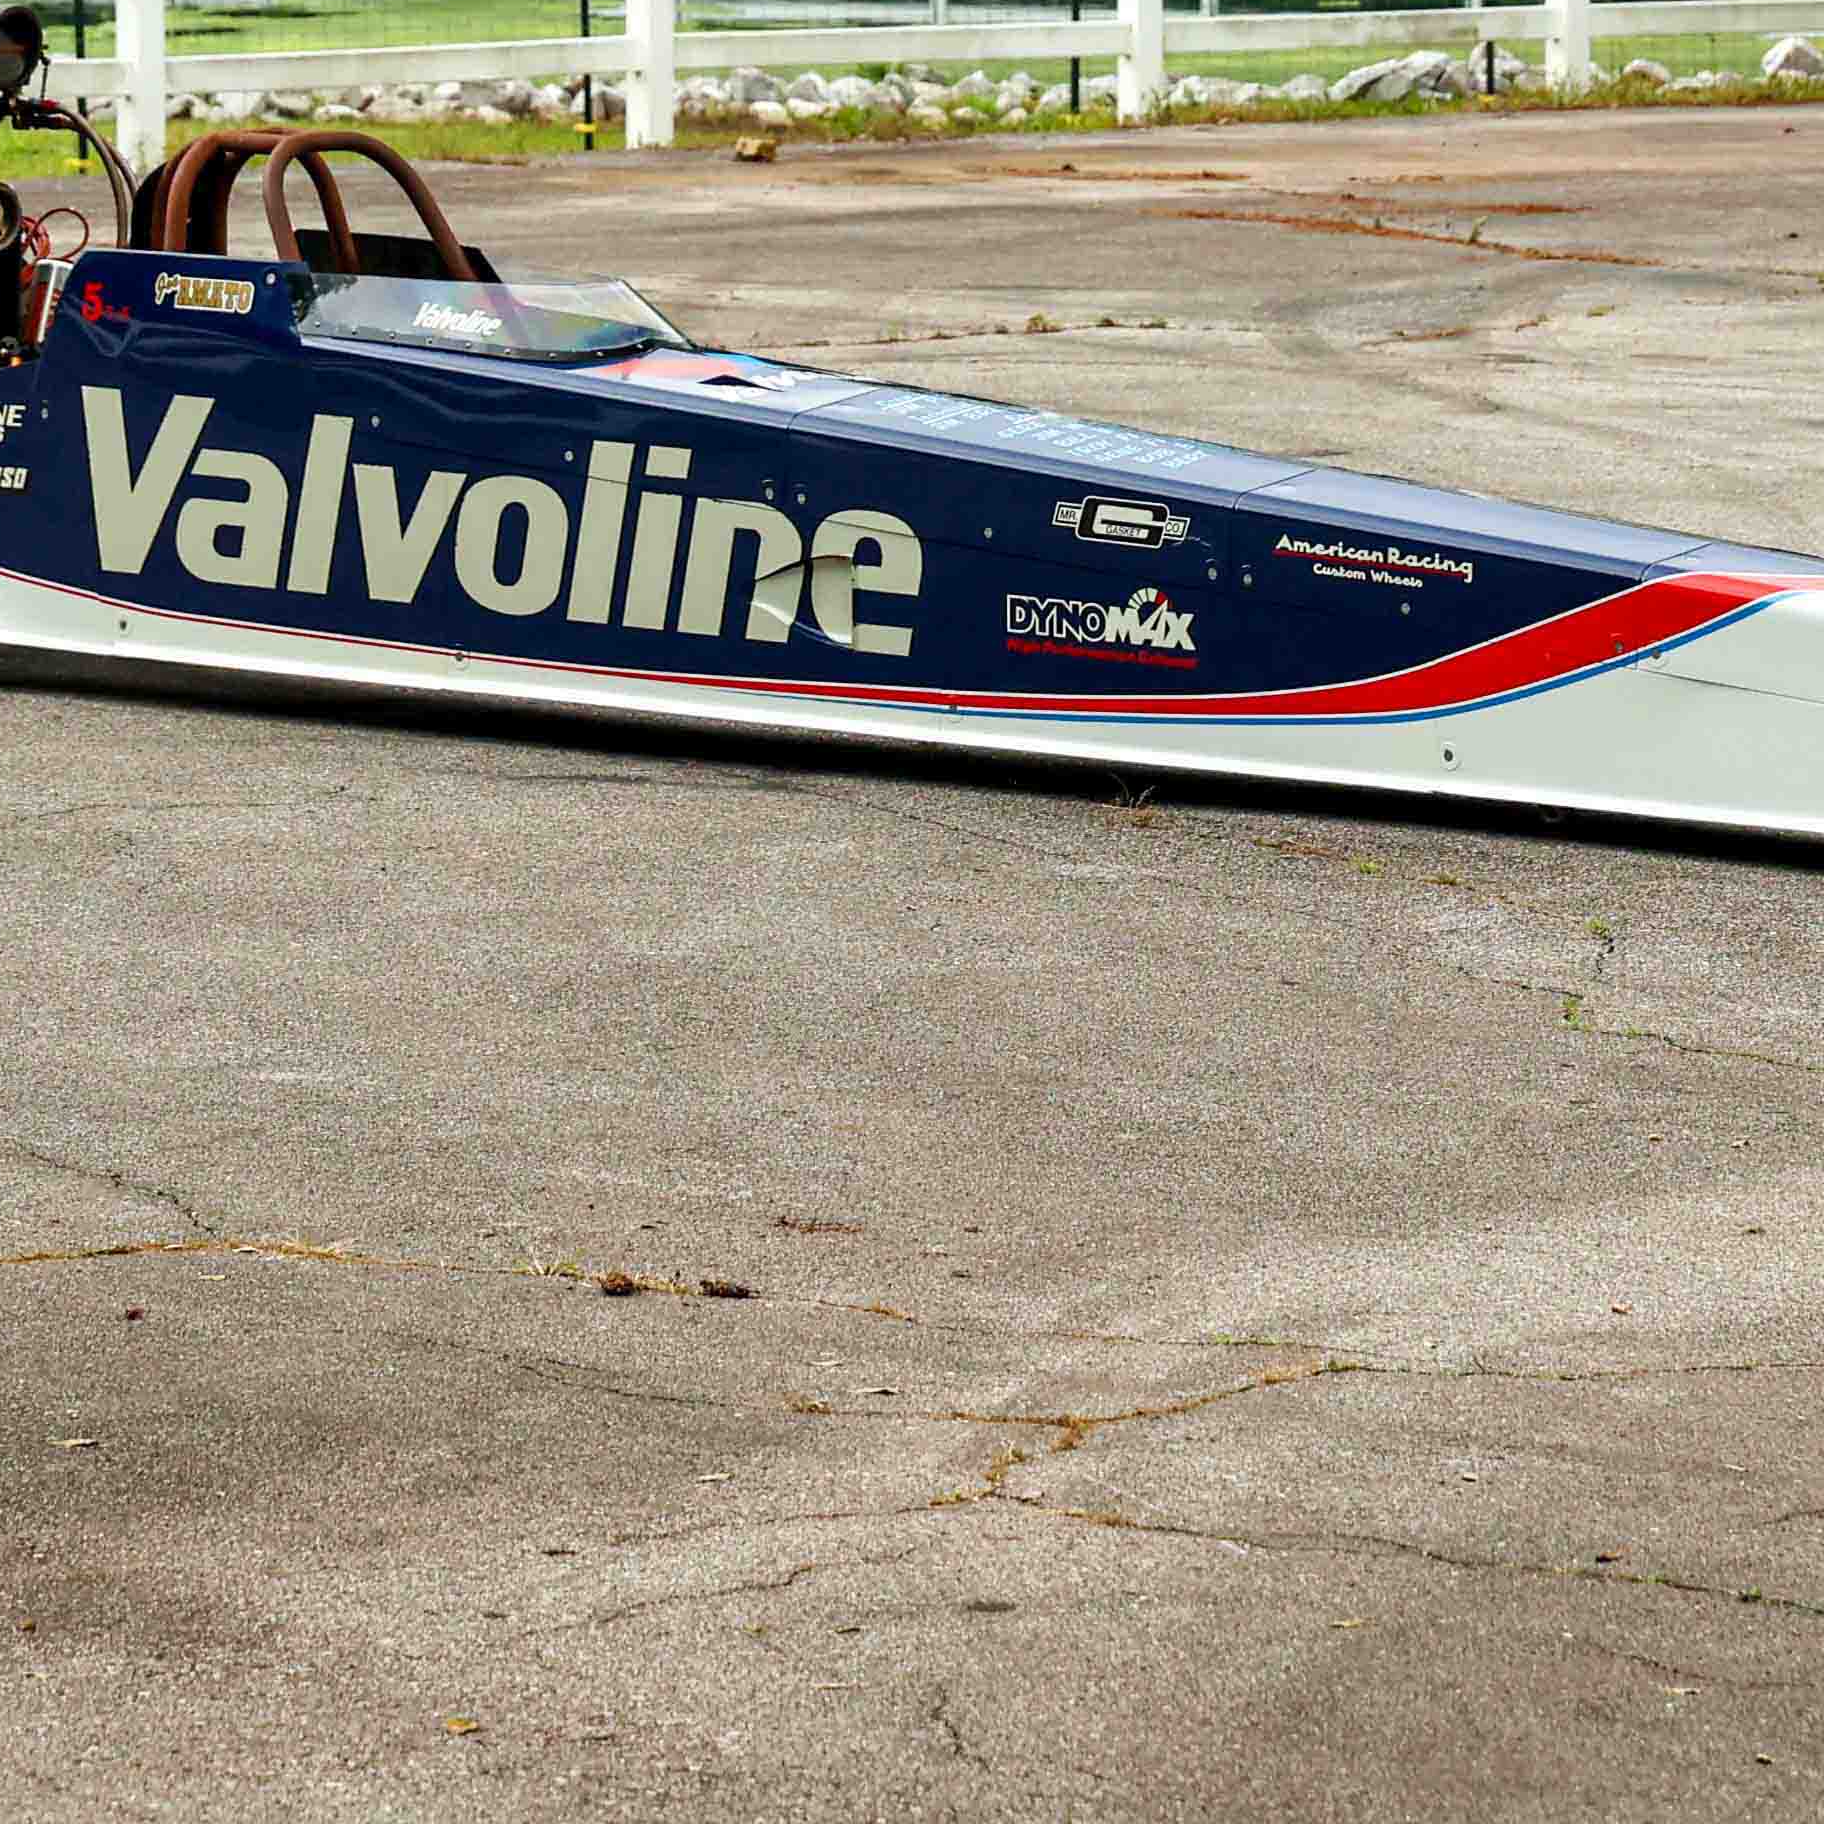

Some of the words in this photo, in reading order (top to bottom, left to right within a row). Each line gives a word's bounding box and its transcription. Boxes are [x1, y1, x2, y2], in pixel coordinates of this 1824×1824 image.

[81, 280, 105, 321] 5
[81, 385, 924, 657] Valvoline
[1105, 526, 1142, 538] GASKET
[1275, 533, 1384, 563] American
[1386, 547, 1473, 583] Racing
[1312, 563, 1366, 581] Custom
[1369, 569, 1424, 588] Wheels
[1006, 587, 1197, 651] DYNOMAX
